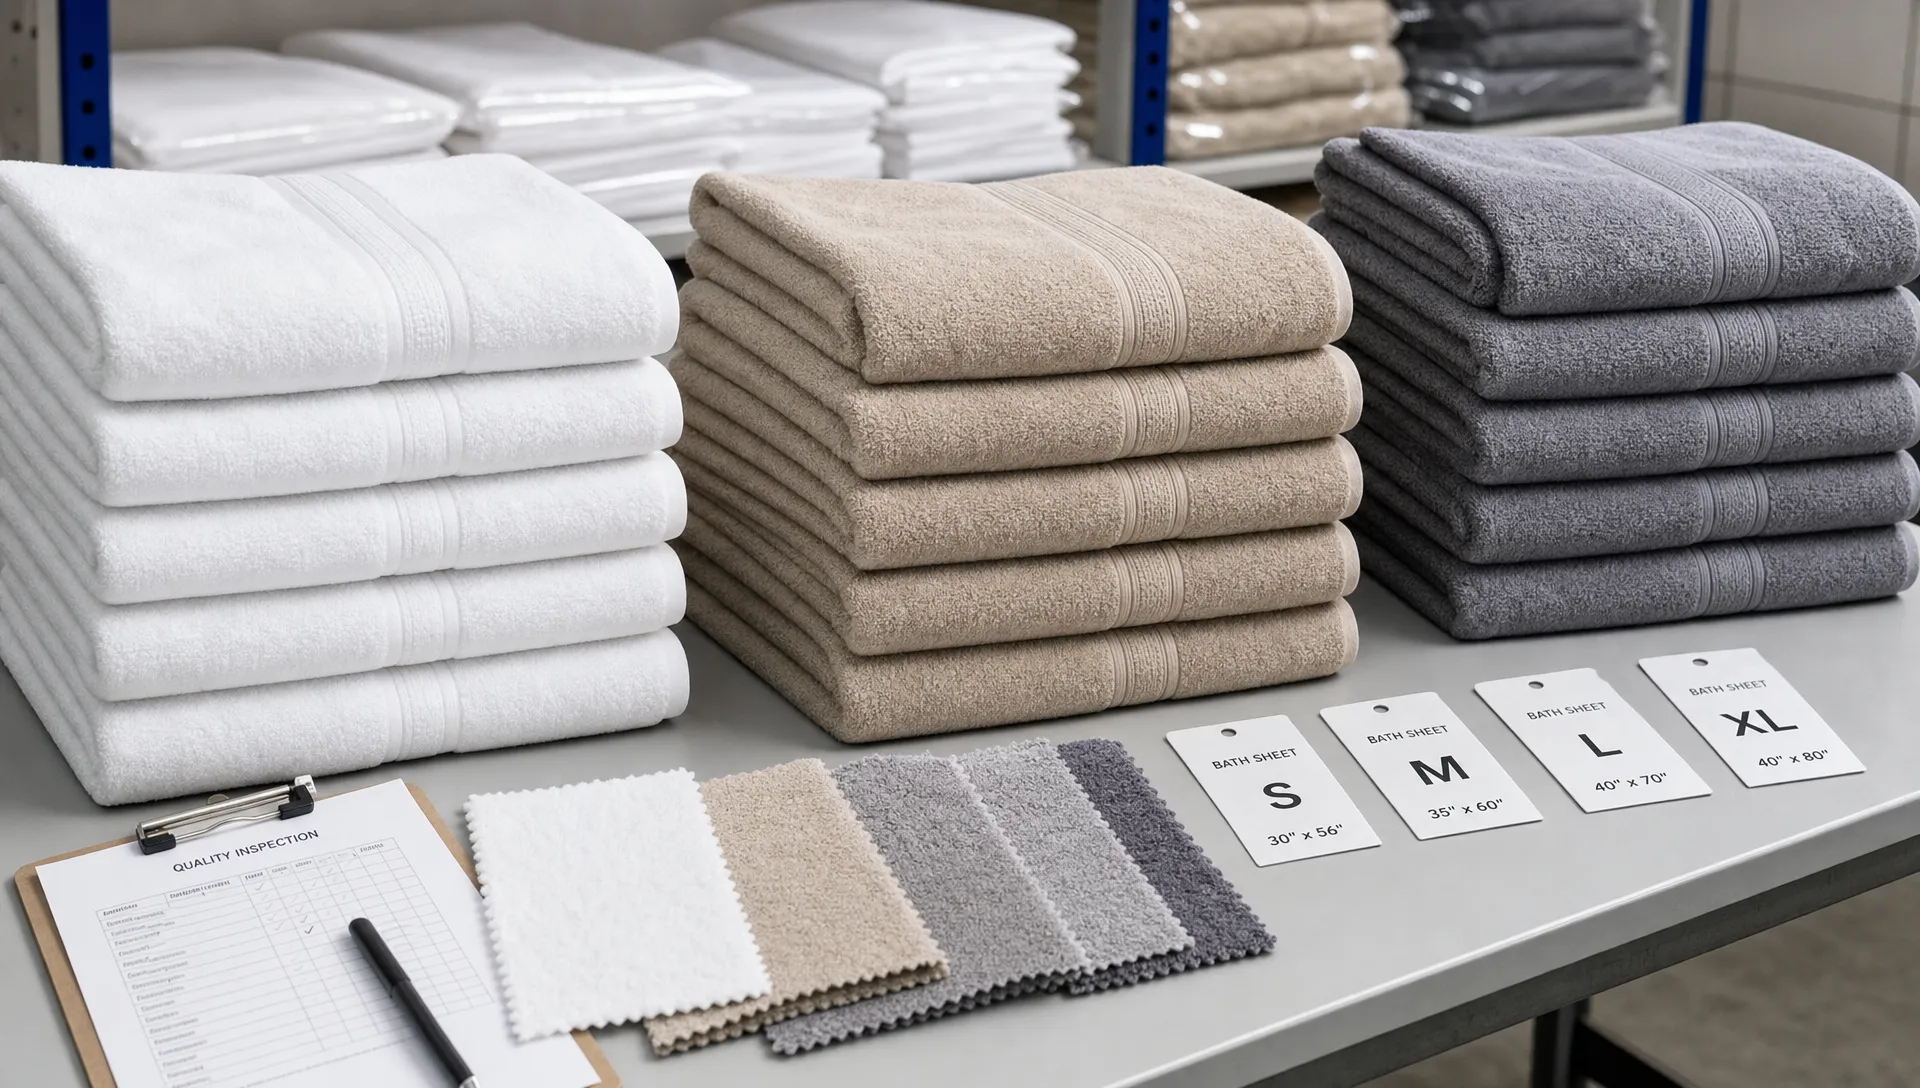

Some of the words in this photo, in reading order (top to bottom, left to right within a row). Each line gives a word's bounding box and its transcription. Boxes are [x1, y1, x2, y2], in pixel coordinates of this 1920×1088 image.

[1689, 685, 1724, 696] BATH
[1726, 679, 1767, 692] SHEET
[1526, 708, 1563, 720] BATH
[1564, 701, 1606, 714] SHEET
[1366, 731, 1404, 744] BATH
[1405, 724, 1449, 738] SHEET
[1720, 709, 1799, 737] XL
[1577, 733, 1623, 758] L
[1211, 756, 1250, 770] BATH
[1252, 748, 1297, 763] SHEET
[1757, 755, 1783, 768] 40"
[1802, 750, 1829, 762] 80"
[1408, 755, 1470, 786] M
[1594, 780, 1621, 792] 40"
[1639, 772, 1668, 785] 70"
[1262, 782, 1302, 810] S
[1427, 806, 1455, 819] 35"
[1476, 799, 1503, 812] 60"
[1267, 831, 1296, 846] 30"
[1315, 823, 1343, 838] 56"
[173, 850, 231, 873] QUALITY
[235, 829, 319, 857] INSPECTION
